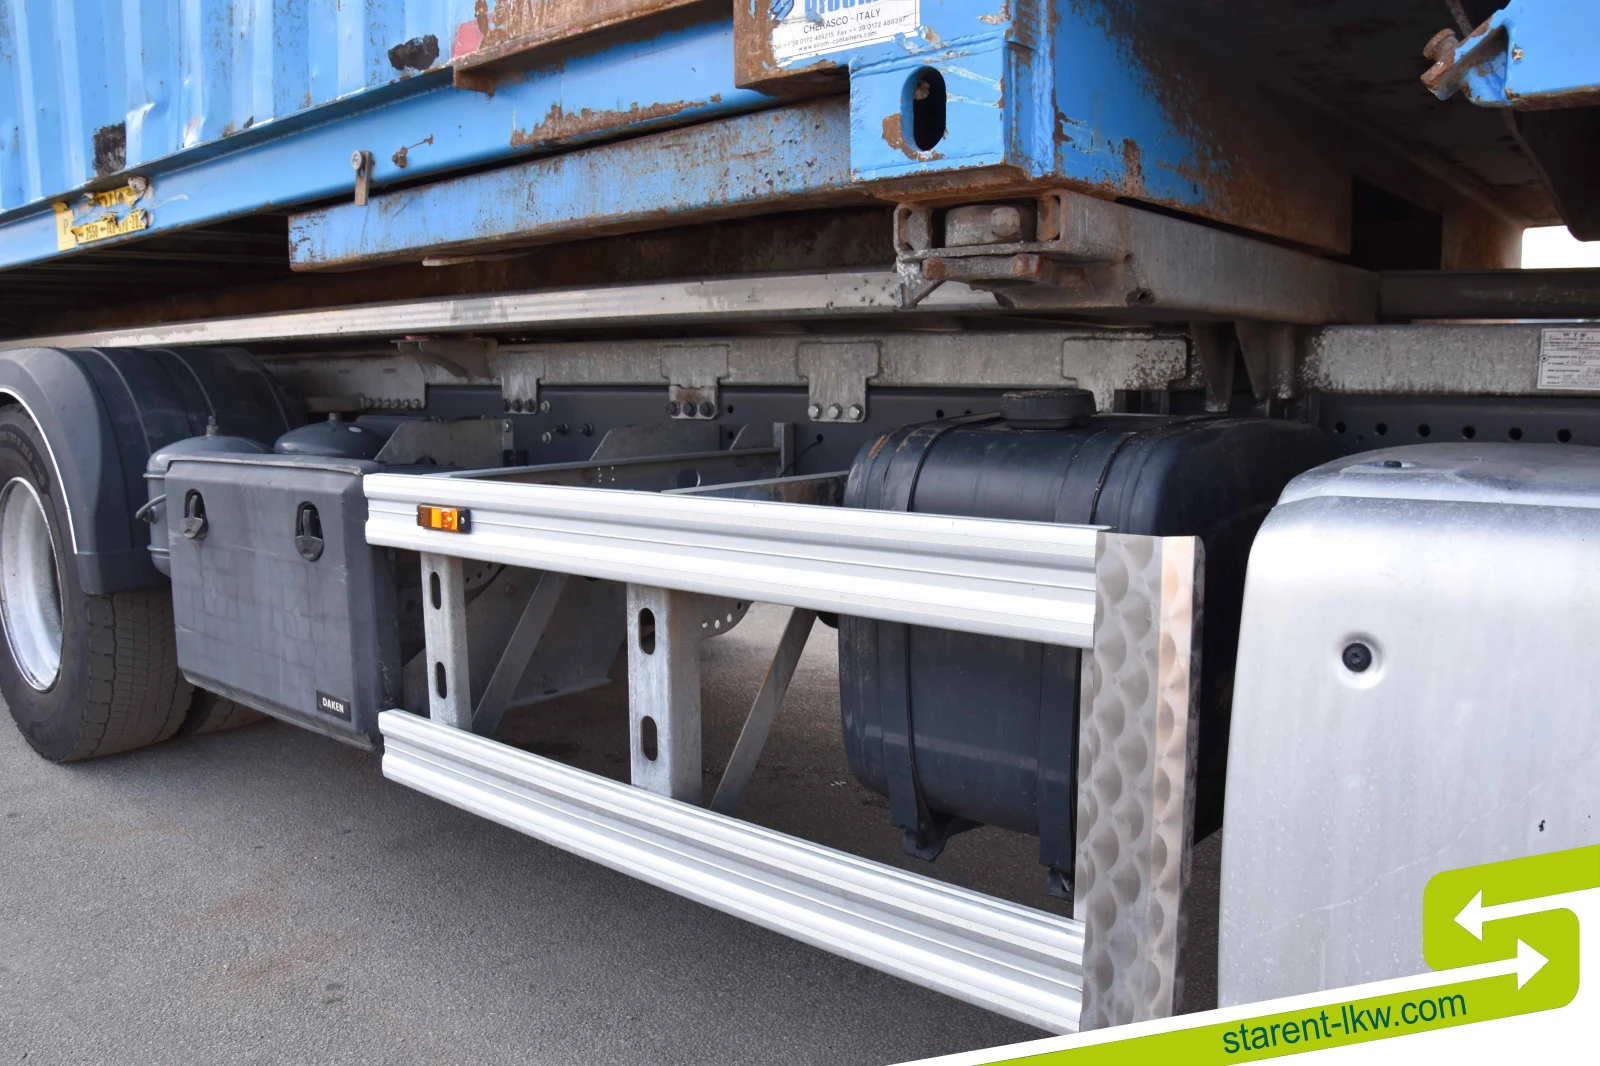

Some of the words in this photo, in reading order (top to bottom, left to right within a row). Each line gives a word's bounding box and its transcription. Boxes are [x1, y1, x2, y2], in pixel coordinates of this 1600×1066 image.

[856, 8, 881, 22] ITALY
[799, 36, 813, 45] 0172
[814, 32, 835, 42] 489215
[837, 29, 847, 37] Fax
[858, 24, 866, 32] 39
[867, 22, 881, 30] 0172
[322, 697, 345, 714] DAKEN
